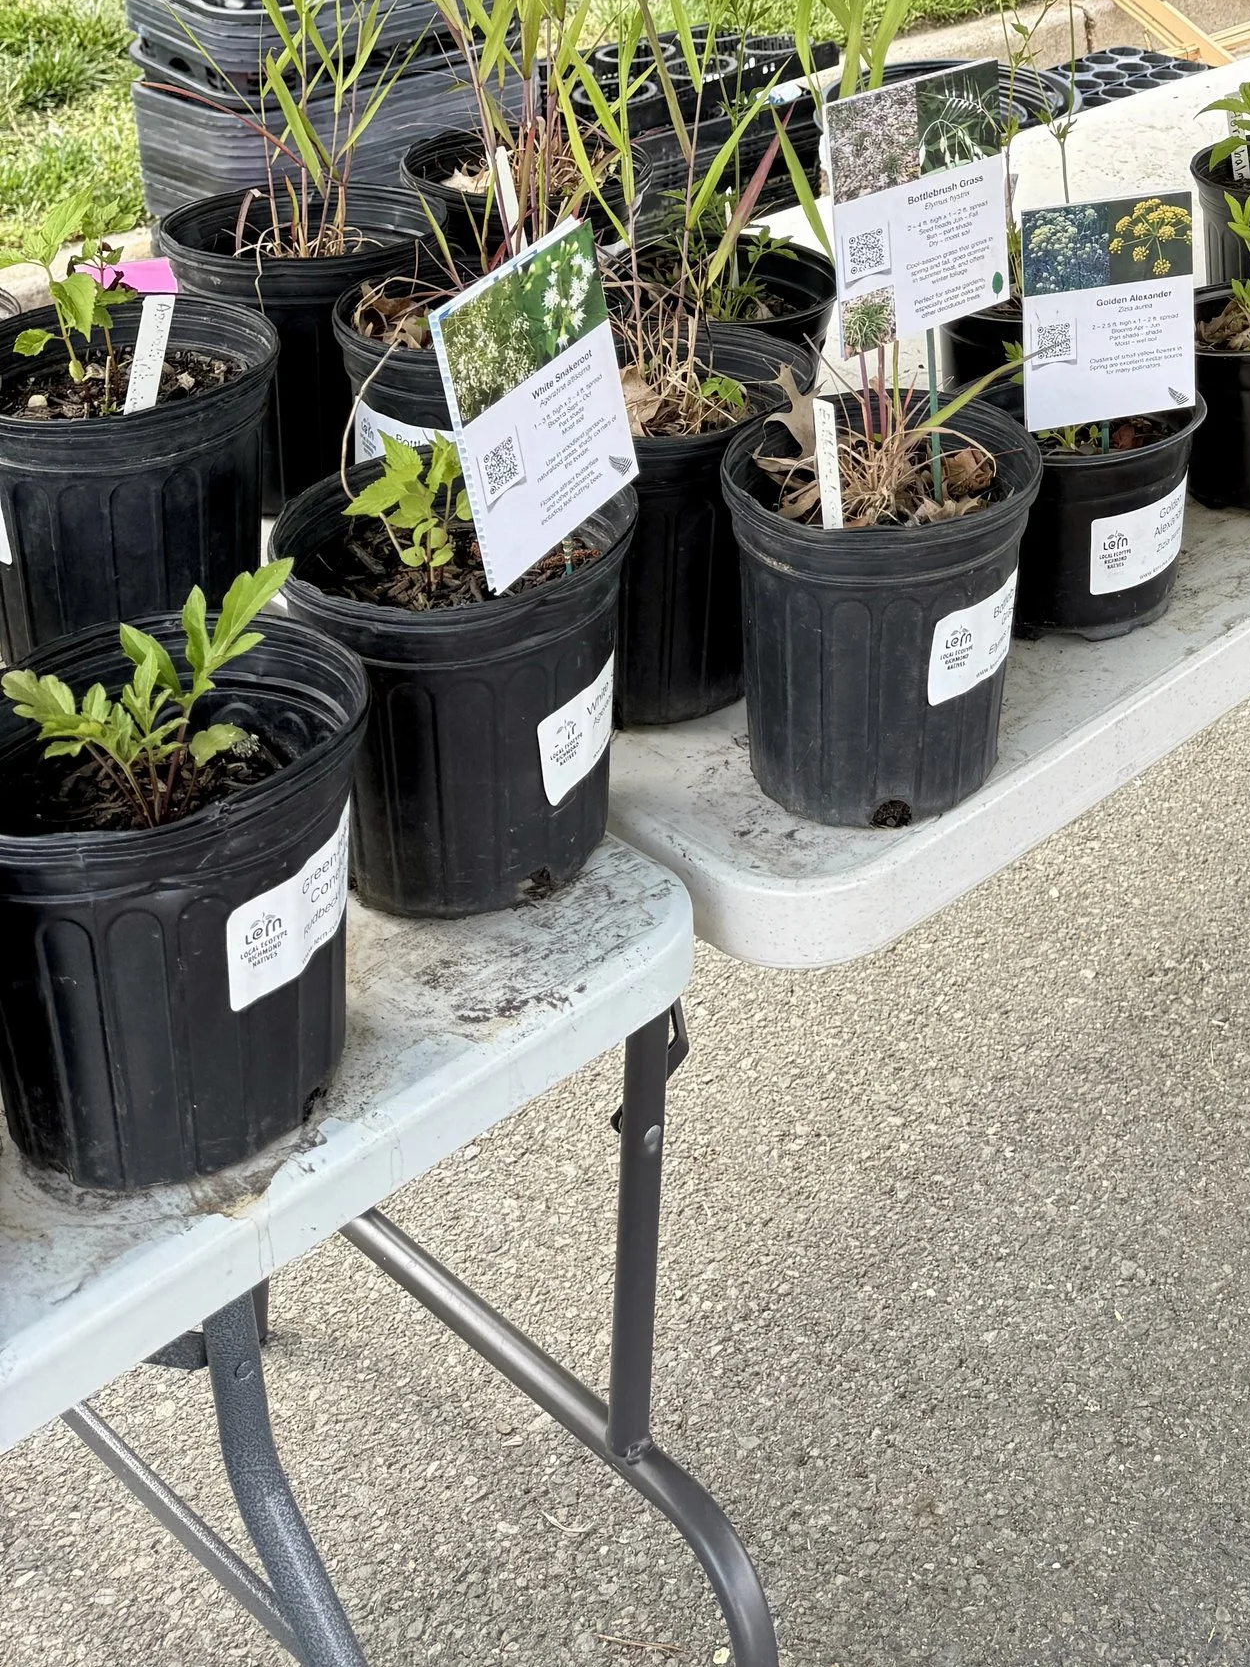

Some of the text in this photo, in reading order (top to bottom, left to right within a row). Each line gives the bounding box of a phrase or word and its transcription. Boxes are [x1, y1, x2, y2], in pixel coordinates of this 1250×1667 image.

[907, 175, 984, 205] Bottlebrush Grass
[914, 295, 935, 306] Perfect
[1096, 290, 1172, 307] Golden Alexander
[530, 348, 594, 401] White Snakeroot
[1100, 552, 1113, 561] LOCAL
[940, 650, 954, 661] LOCAL
[945, 653, 969, 665] RICHMOND
[240, 929, 289, 961] LOCAL ECOTYPE
[248, 940, 283, 964] RICHMOND
[252, 950, 279, 969] NATIVES
